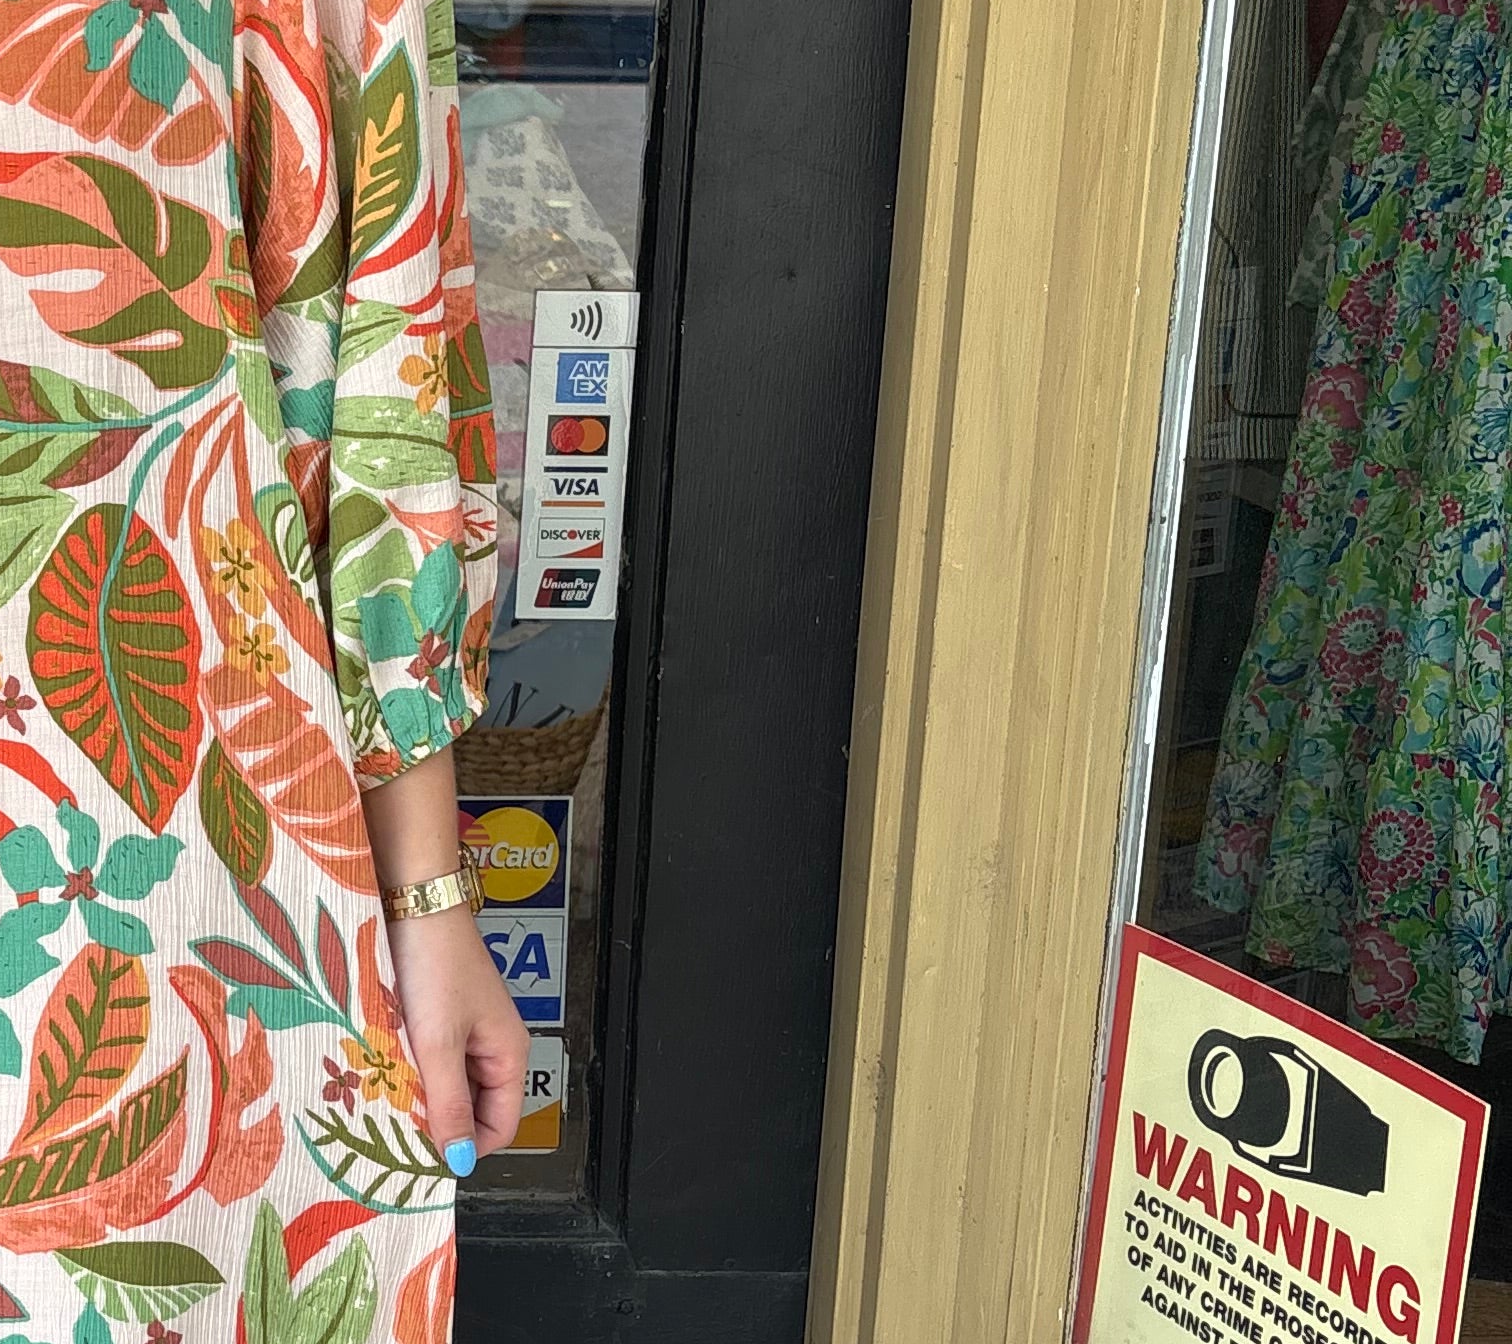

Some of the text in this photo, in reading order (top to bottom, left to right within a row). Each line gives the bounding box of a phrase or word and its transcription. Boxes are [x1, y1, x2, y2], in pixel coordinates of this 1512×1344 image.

[570, 361, 609, 378] AM
[575, 378, 607, 394] EX
[550, 478, 599, 495] VISA
[541, 529, 601, 540] DISCOVER
[542, 578, 595, 595] UnionPay
[482, 932, 551, 979] SA
[1134, 1189, 1237, 1265] ACTIVITIES
[1241, 1254, 1283, 1295] ARE
[1124, 1210, 1149, 1241] TO
[1153, 1231, 1187, 1264] AID
[1191, 1252, 1212, 1281] IN
[1217, 1267, 1256, 1310] THE
[1128, 1245, 1153, 1272] OF
[1156, 1264, 1197, 1300] ANY
